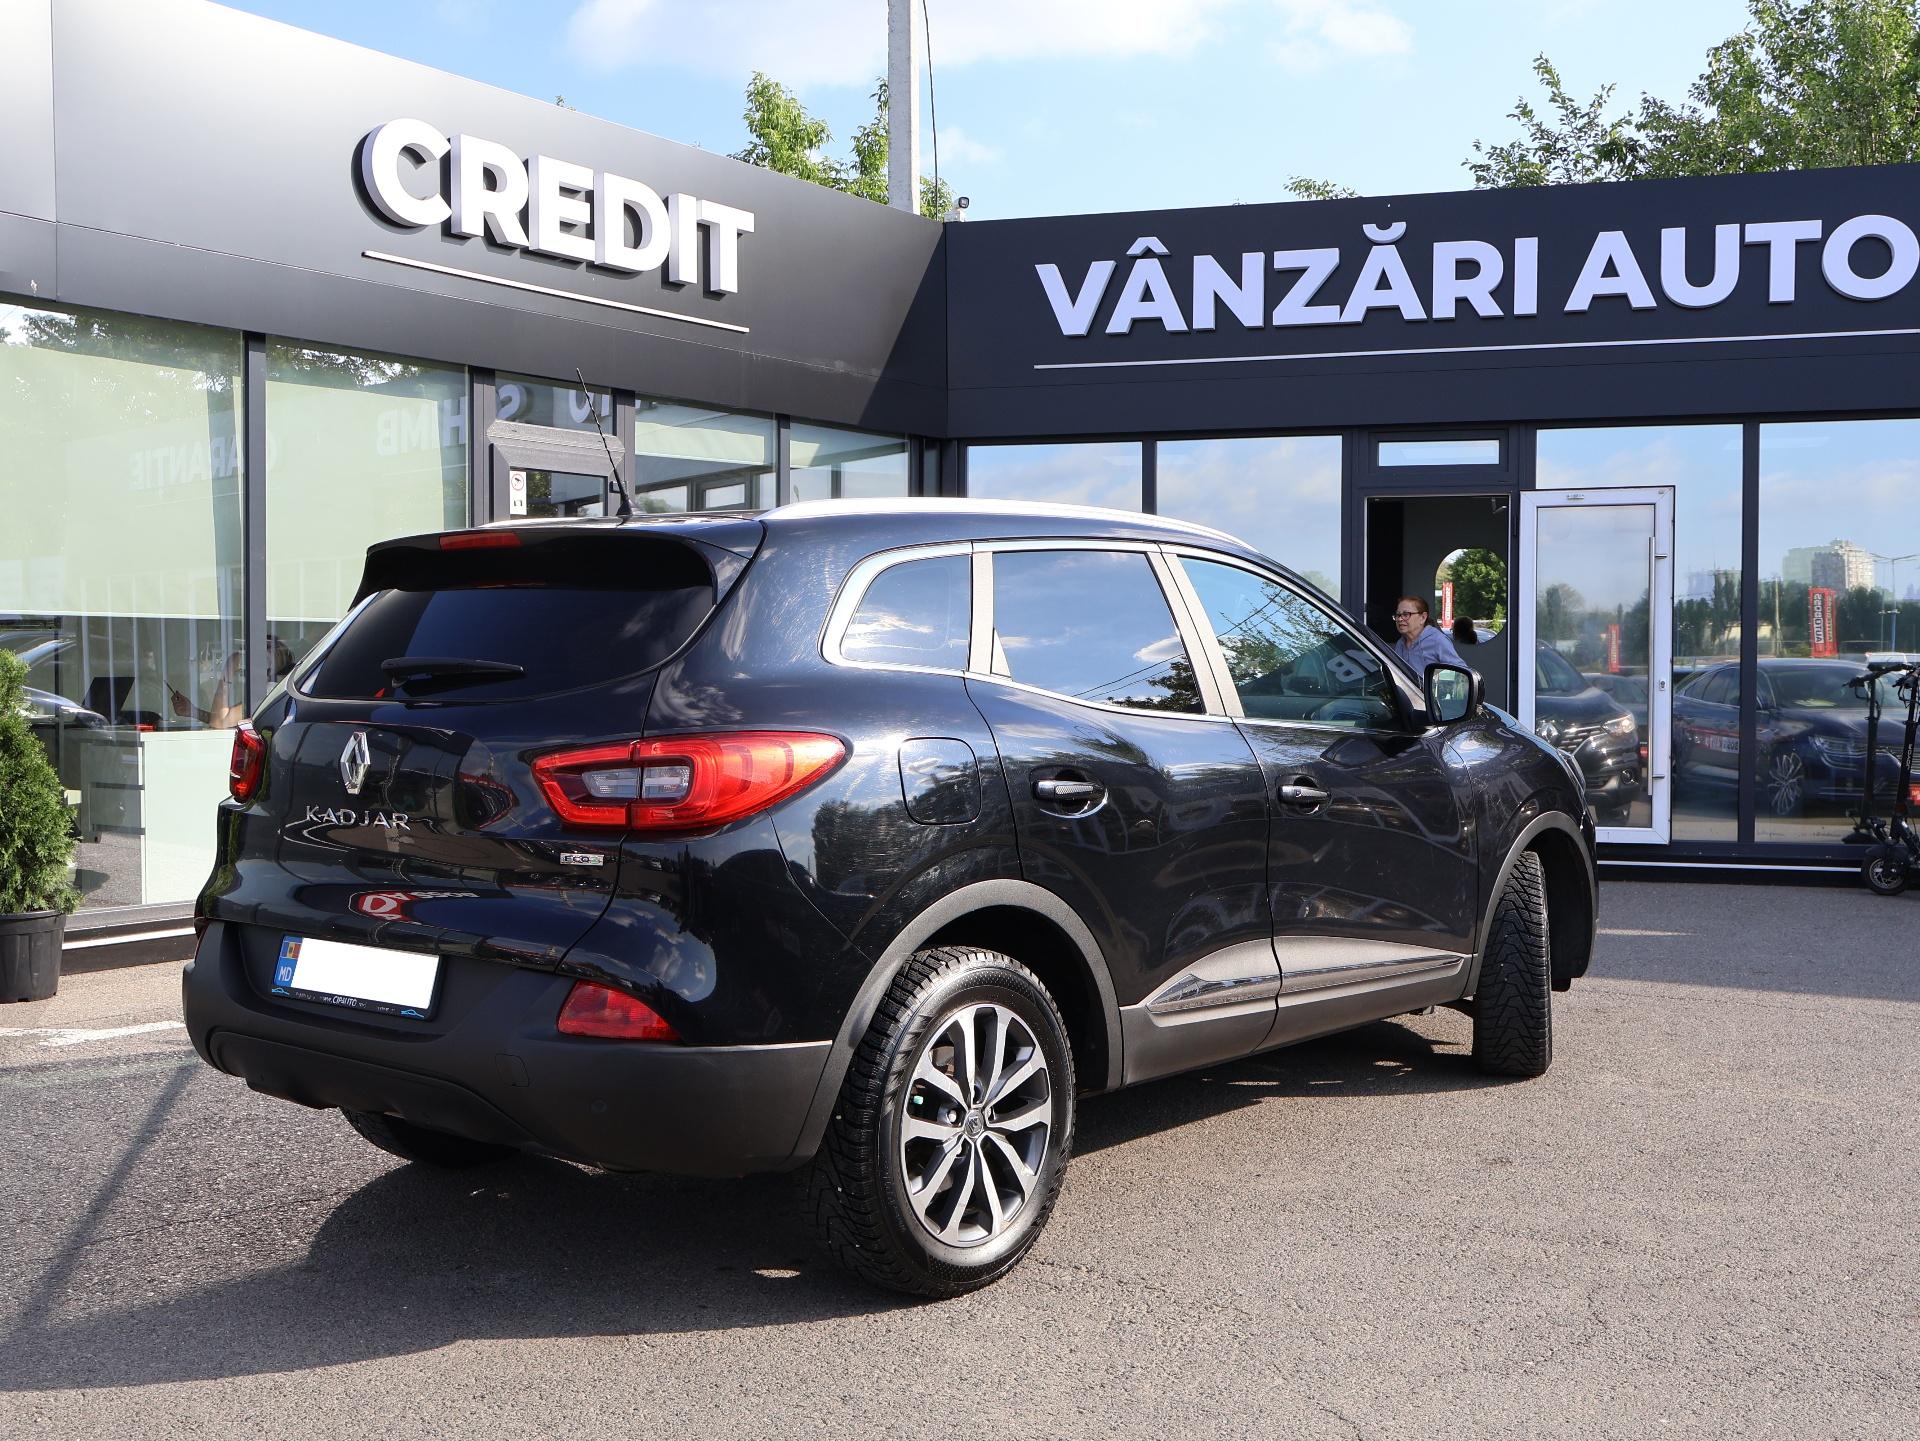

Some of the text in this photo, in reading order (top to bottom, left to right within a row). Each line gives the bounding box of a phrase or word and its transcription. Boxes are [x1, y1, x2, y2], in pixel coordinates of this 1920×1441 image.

[360, 118, 755, 294] CREDIT
[1035, 214, 1920, 337] VÂNZĂRI AUTO
[306, 805, 411, 831] KADJAR
[278, 965, 293, 982] MD
